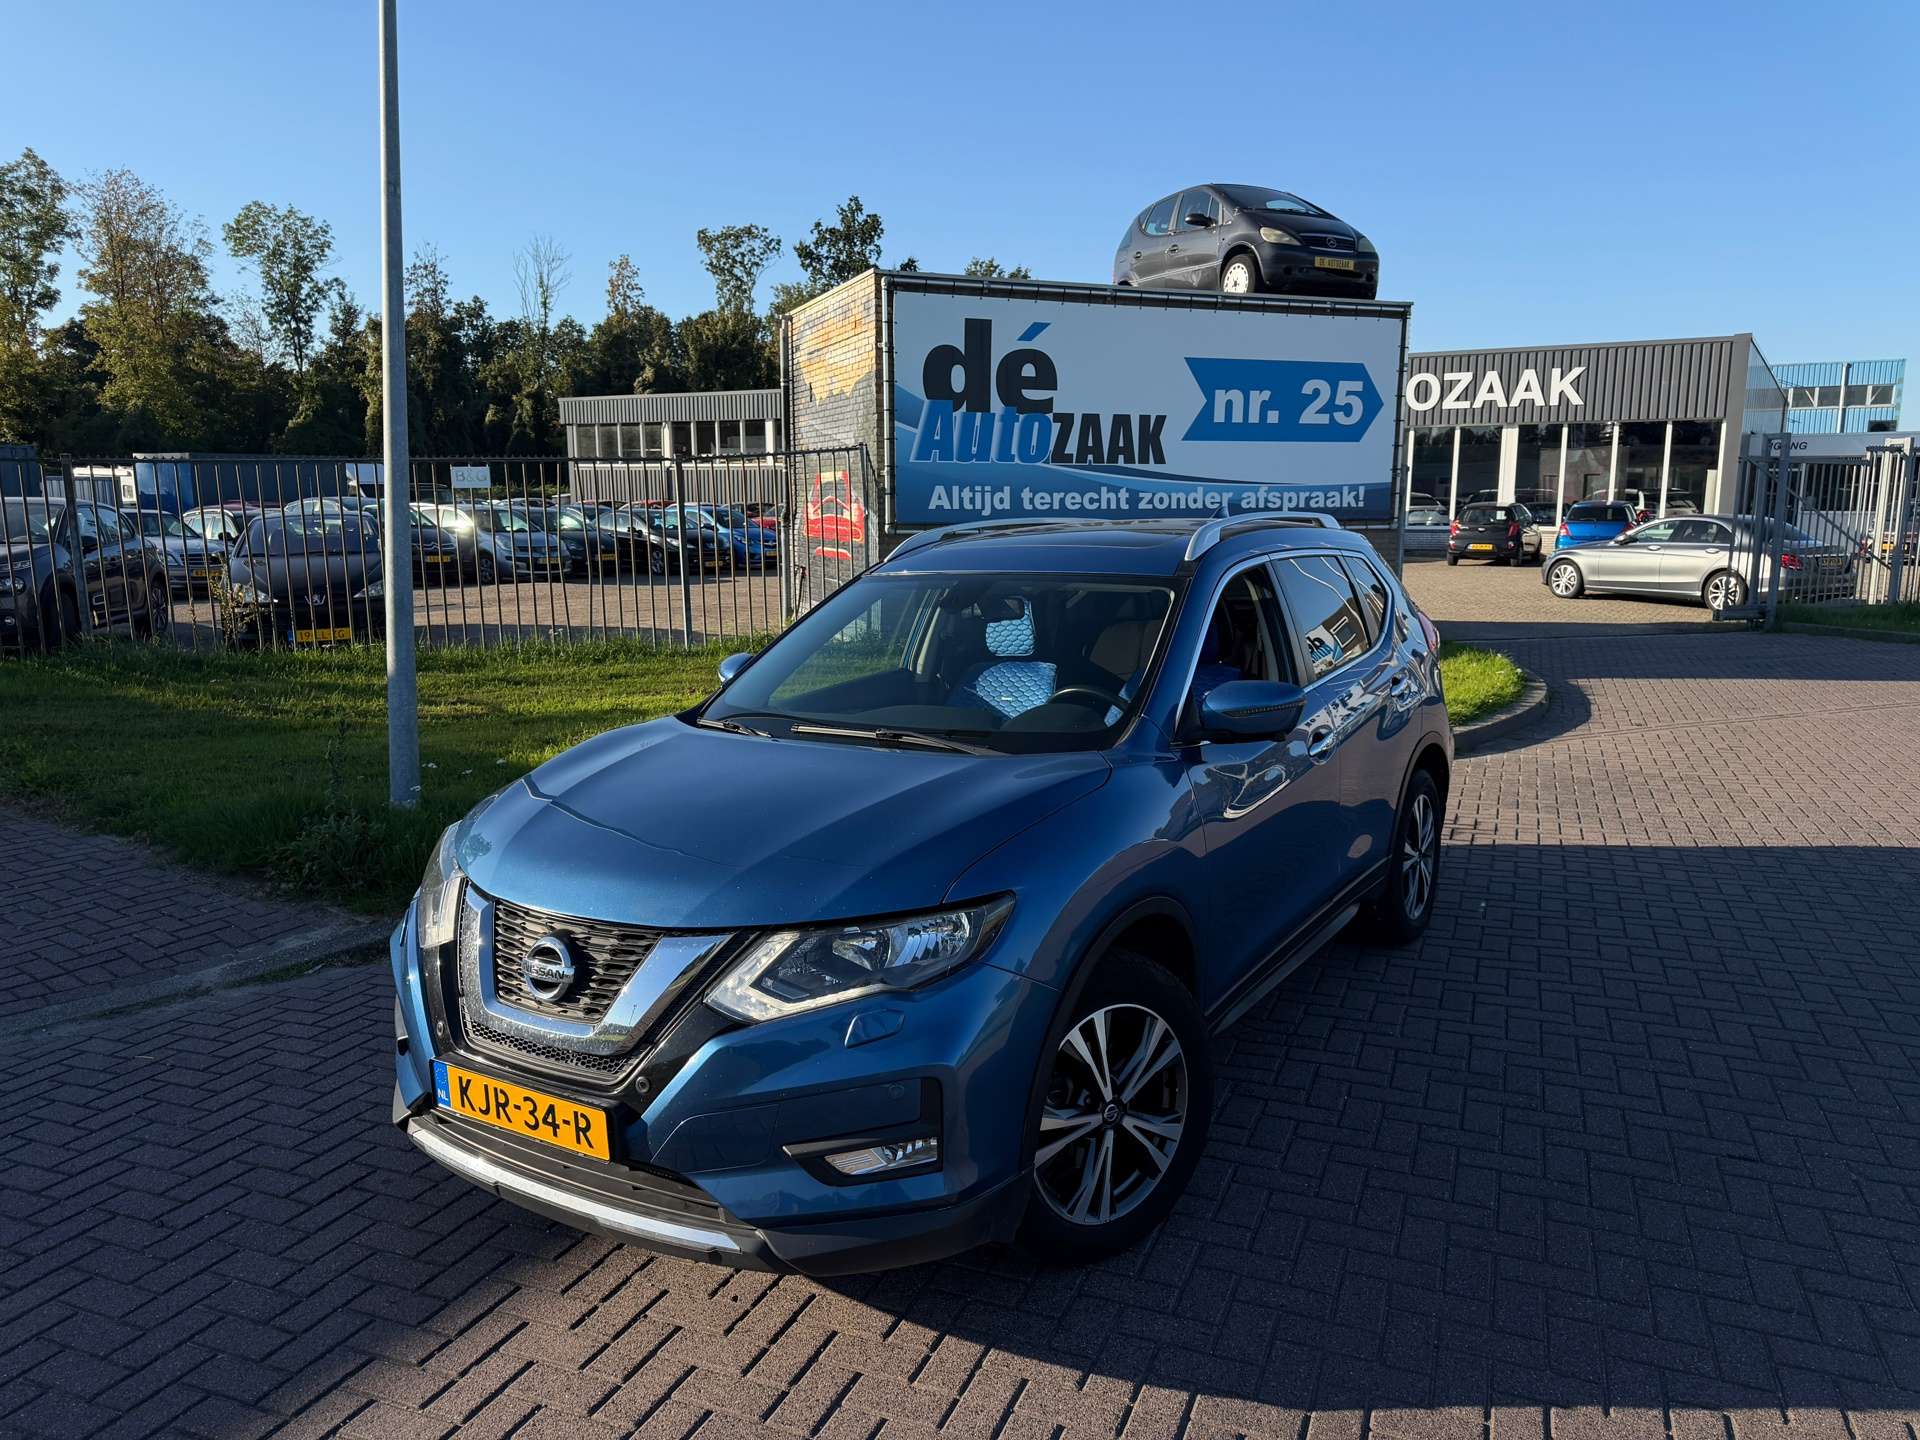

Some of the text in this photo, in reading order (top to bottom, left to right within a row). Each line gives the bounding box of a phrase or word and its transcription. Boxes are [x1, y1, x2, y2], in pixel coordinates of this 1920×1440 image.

[922, 318, 1058, 414] dé
[1405, 366, 1587, 411] OZAAK
[1213, 379, 1364, 425] nr. 25
[928, 485, 1366, 516] Altijd terecht zonder afspraak!
[522, 960, 566, 980] NISSAN
[437, 1075, 594, 1150] NL KJR-34-R
